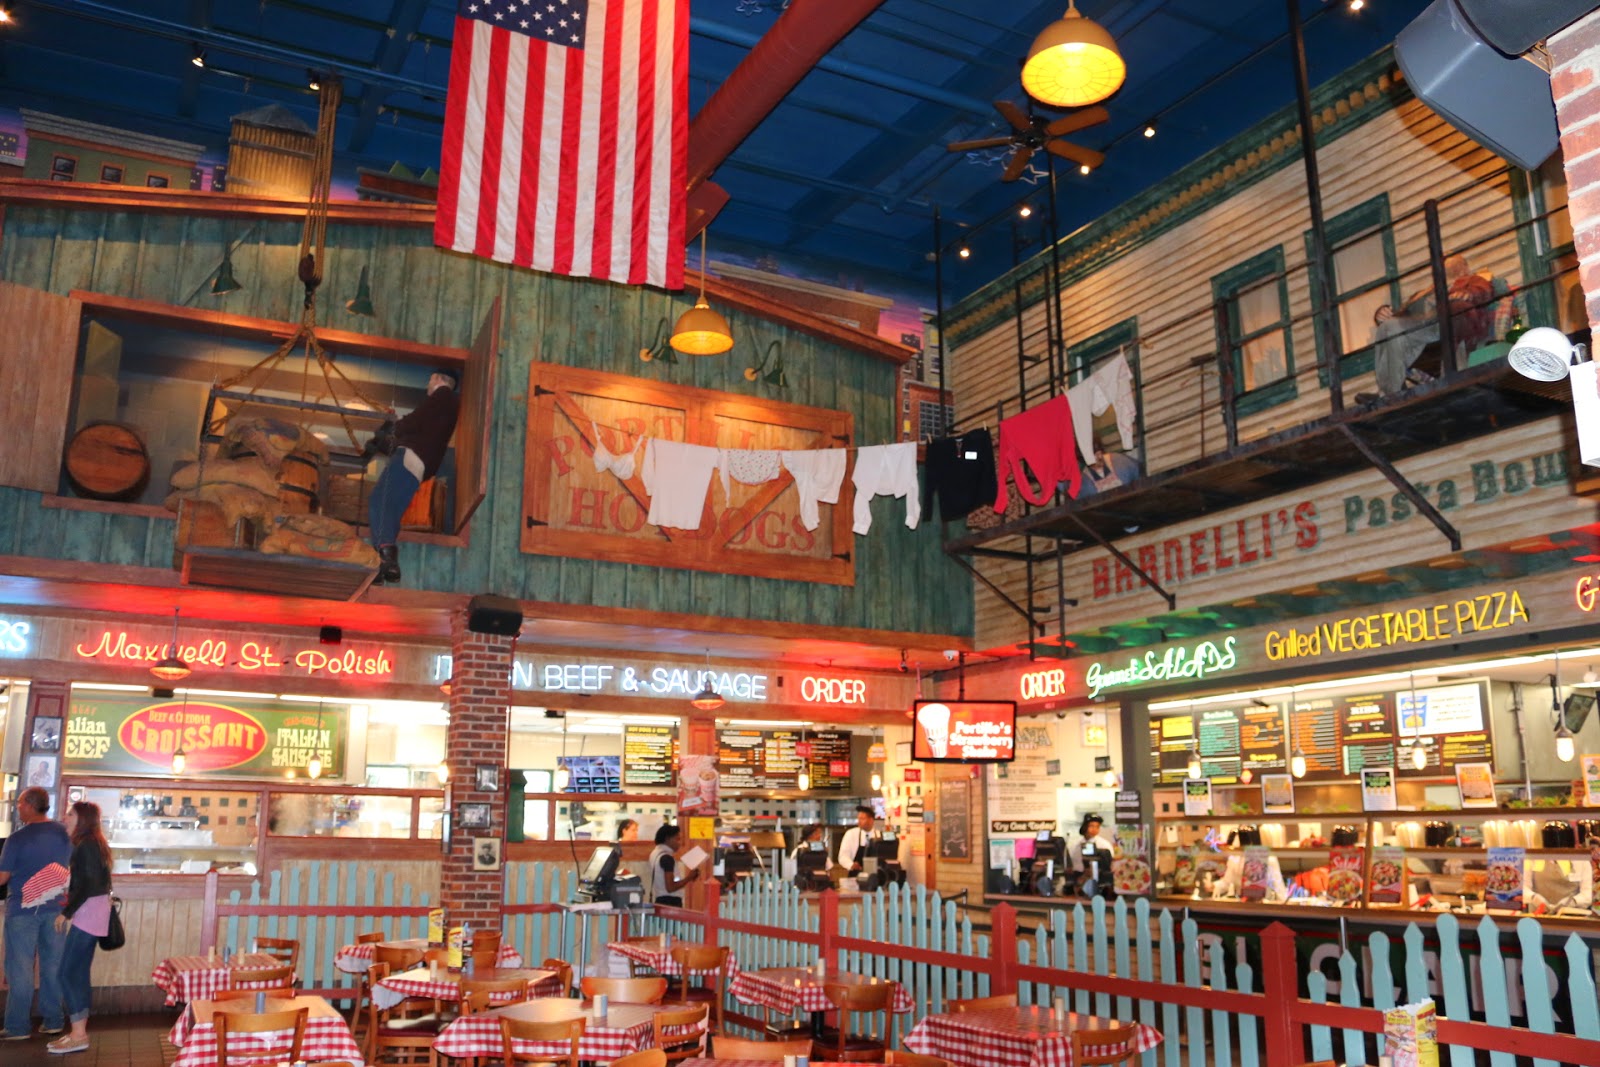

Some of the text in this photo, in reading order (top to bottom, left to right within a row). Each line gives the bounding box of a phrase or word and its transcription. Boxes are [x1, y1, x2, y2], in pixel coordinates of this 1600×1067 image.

[1092, 501, 1319, 599] BARNELLI'S
[1265, 590, 1530, 662] Grilled VEGETABLE PIZZA
[295, 649, 393, 676] Polish
[544, 664, 614, 690] BEEF
[622, 665, 640, 692] &
[650, 667, 768, 700] SAUSAGE
[800, 675, 866, 704] ORDER
[1020, 669, 1066, 700] ORDER
[149, 710, 168, 722] BEEF
[955, 720, 1012, 735] Portillo's
[130, 720, 259, 753] CROISSANT
[949, 733, 1014, 749] Strawberry
[961, 745, 997, 758] Shake
